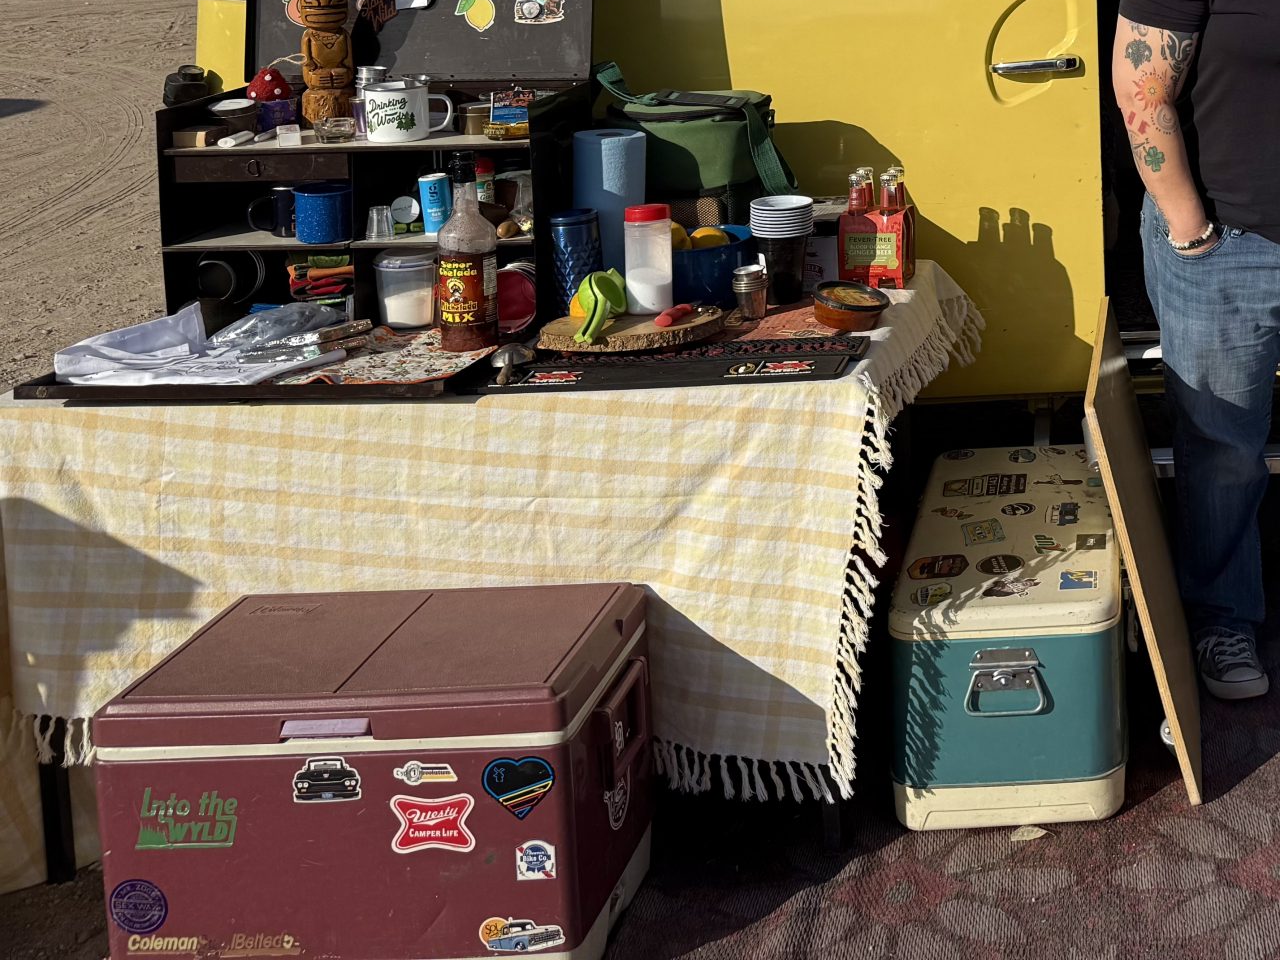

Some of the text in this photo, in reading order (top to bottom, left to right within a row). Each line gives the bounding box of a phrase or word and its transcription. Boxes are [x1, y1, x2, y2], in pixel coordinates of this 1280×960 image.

[369, 97, 408, 114] Drinking
[372, 111, 406, 127] Woods
[439, 267, 478, 277] Chelada
[140, 787, 238, 817] Into the
[406, 806, 459, 823] Westy
[168, 817, 229, 842] WYLD
[409, 828, 459, 837] CAMPER LIFE
[127, 934, 198, 951] Coleman
